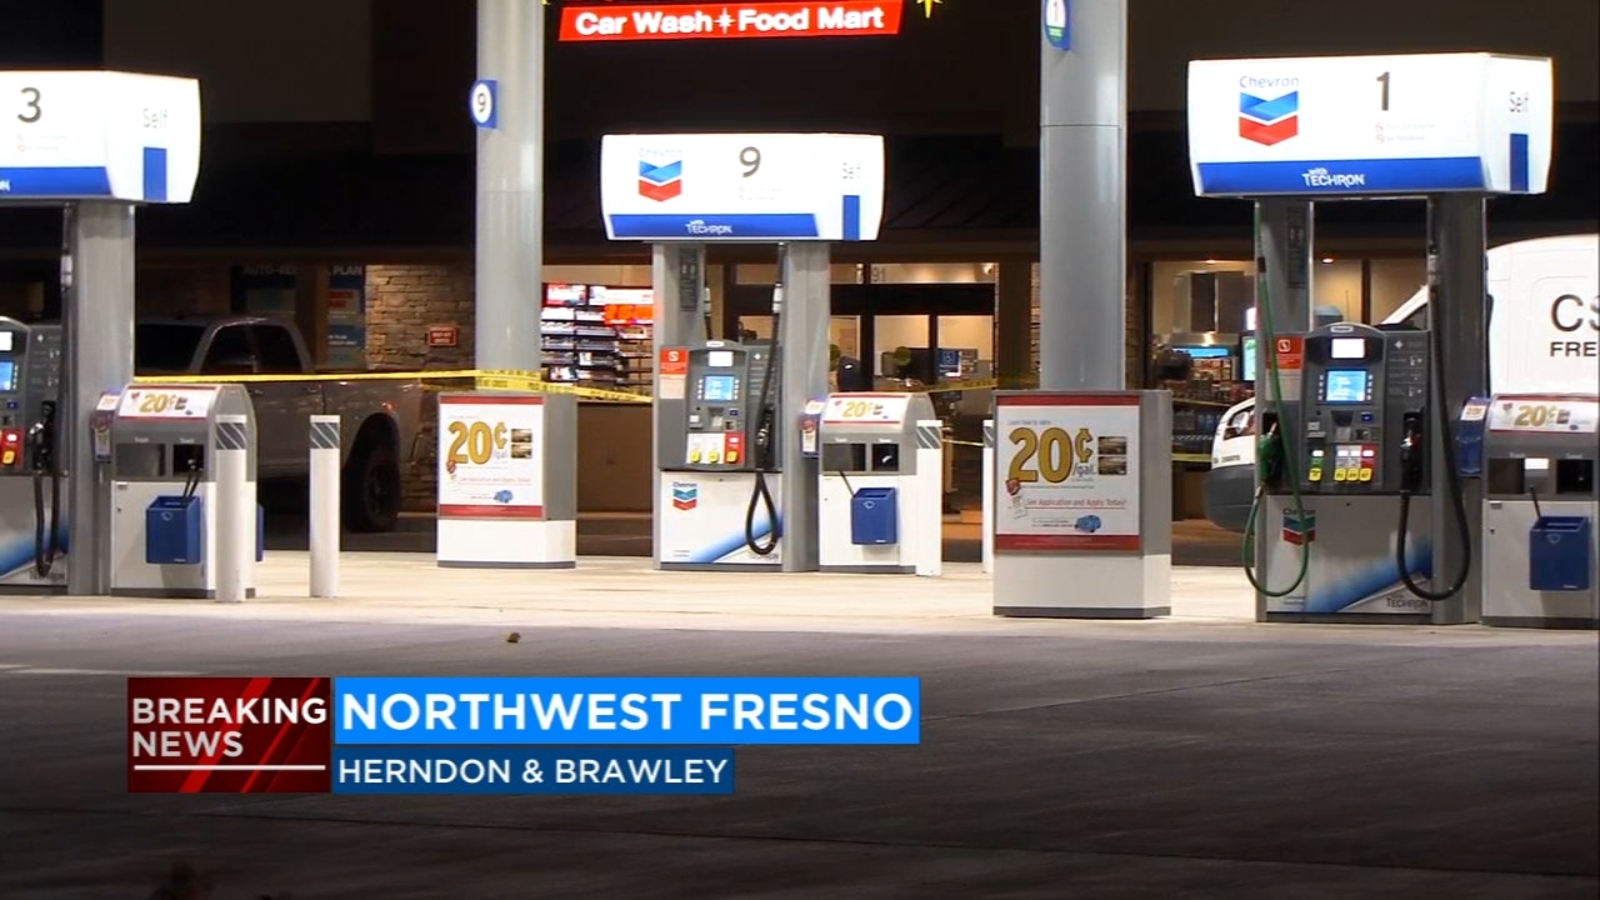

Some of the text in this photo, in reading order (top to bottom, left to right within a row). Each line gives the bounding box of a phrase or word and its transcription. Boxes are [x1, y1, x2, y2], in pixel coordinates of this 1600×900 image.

[575, 7, 884, 35] Car Wash Food Mart
[1239, 75, 1299, 89] Chevron
[1376, 71, 1390, 111] 1
[17, 87, 41, 123] 3
[477, 92, 486, 113] 9
[739, 146, 761, 177] 9
[1301, 173, 1366, 188] TECHRON
[448, 420, 508, 465] 20¢
[1008, 427, 1094, 484] 20¢
